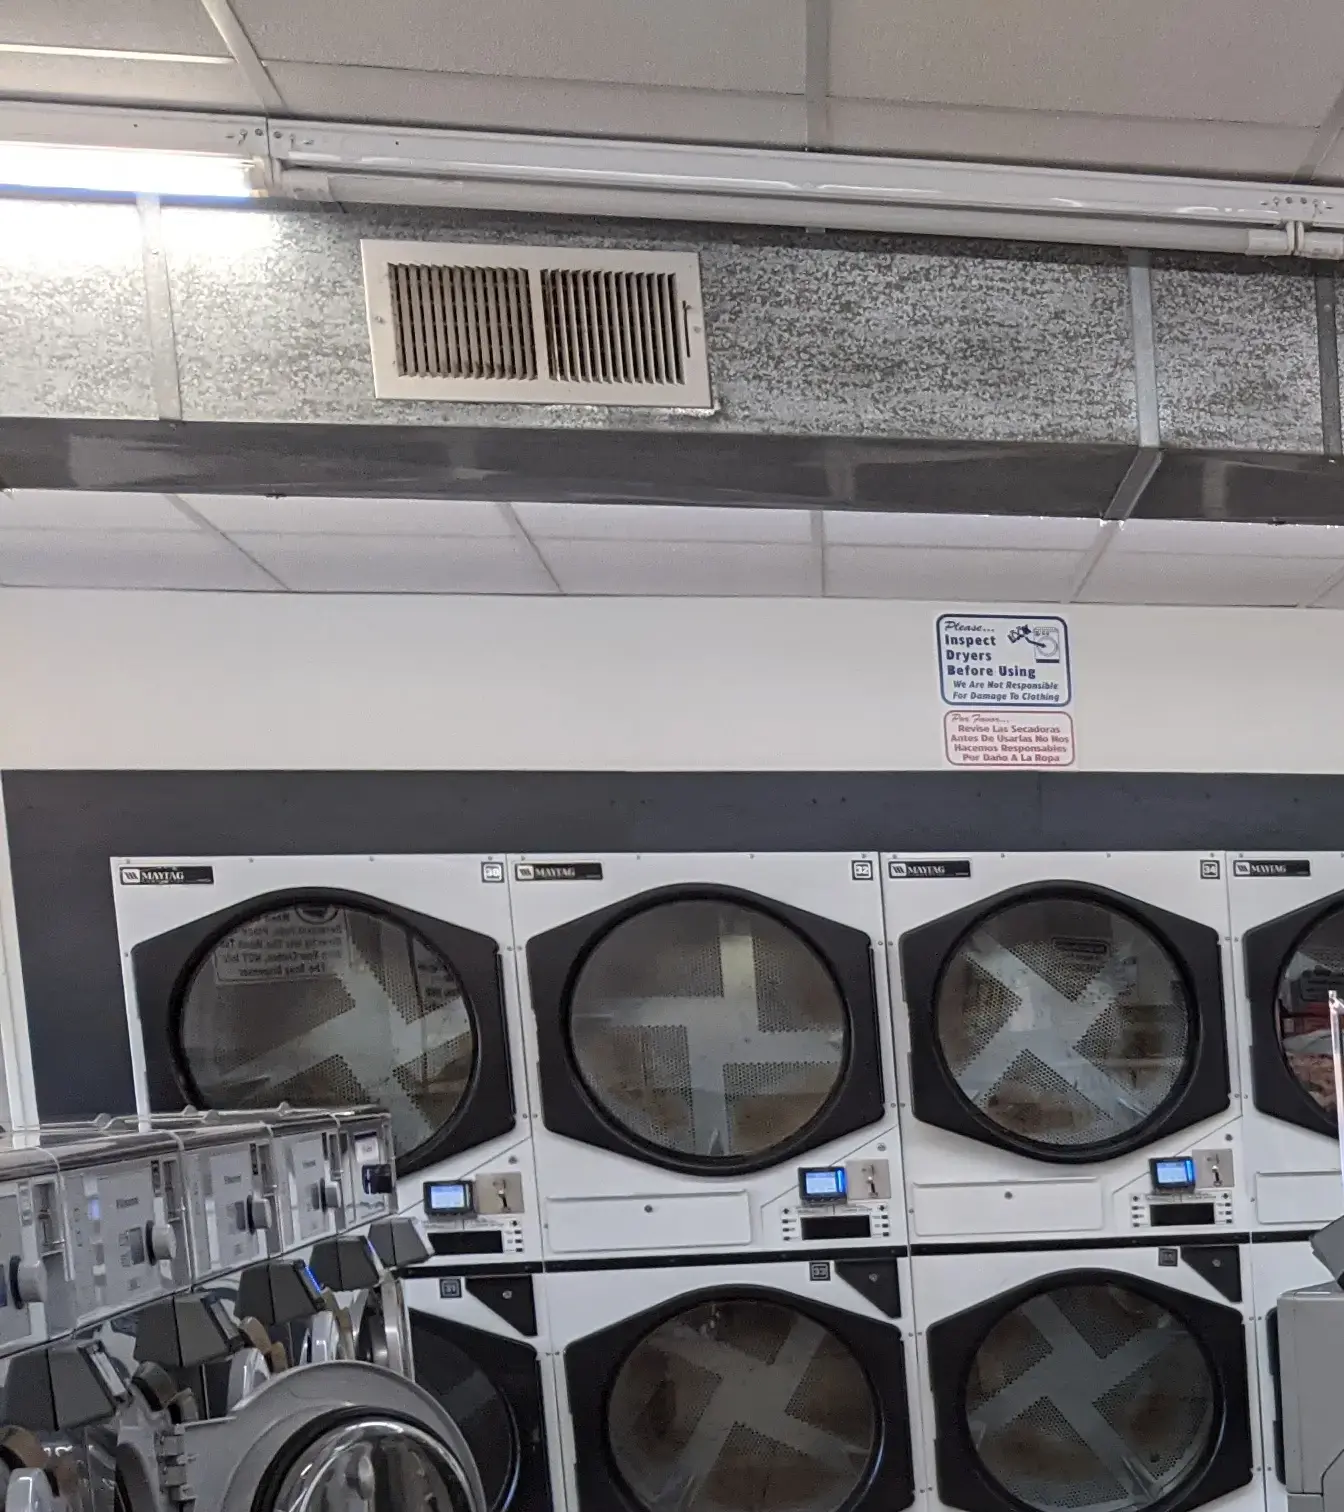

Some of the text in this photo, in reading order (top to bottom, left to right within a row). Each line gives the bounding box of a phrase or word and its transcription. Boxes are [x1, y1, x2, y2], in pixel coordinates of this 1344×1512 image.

[944, 634, 997, 647] Inspect
[946, 650, 992, 662] Dryers
[947, 665, 1036, 679] Before Using
[953, 680, 1059, 690] We Are Not Responsible
[953, 692, 1059, 702] For Damage To Clothing
[958, 725, 1061, 733] Revise Las Secadoras
[534, 866, 576, 877] MAYTAG
[856, 866, 869, 874] 32
[907, 864, 945, 875] MAYTAG
[1250, 864, 1286, 874] MAYTAG
[141, 871, 184, 880] MAYTAG
